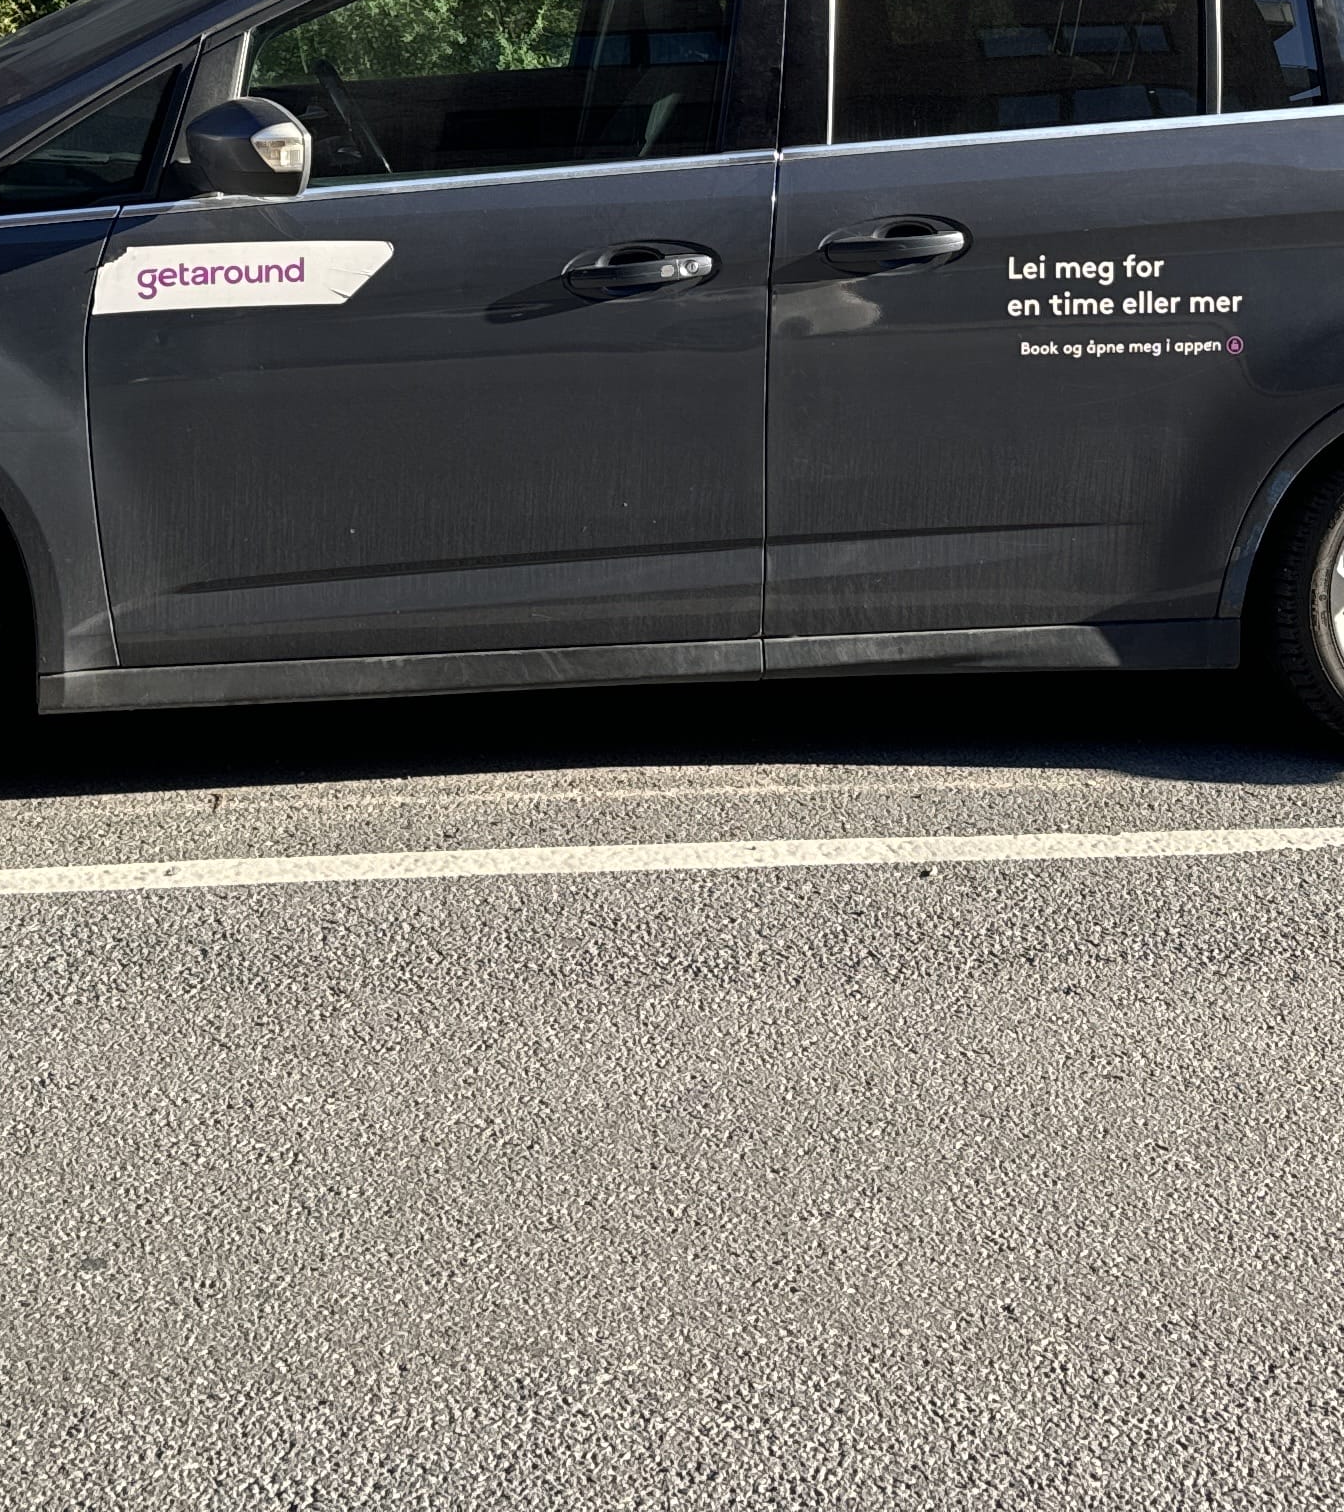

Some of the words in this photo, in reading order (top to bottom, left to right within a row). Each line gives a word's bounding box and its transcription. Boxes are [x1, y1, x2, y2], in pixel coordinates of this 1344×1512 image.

[137, 257, 305, 300] getaround
[1008, 254, 1046, 280] Lei
[1054, 259, 1114, 286] meg
[1123, 254, 1165, 278] for
[1007, 297, 1040, 317] en
[1048, 291, 1115, 316] time
[1122, 290, 1181, 315] eller
[1189, 294, 1243, 314] mer
[1020, 341, 1059, 356] Book
[1063, 343, 1083, 359] og
[1086, 339, 1125, 357] åpne
[1128, 341, 1162, 357] meg
[1165, 338, 1171, 353] i
[1174, 340, 1222, 357] appen
